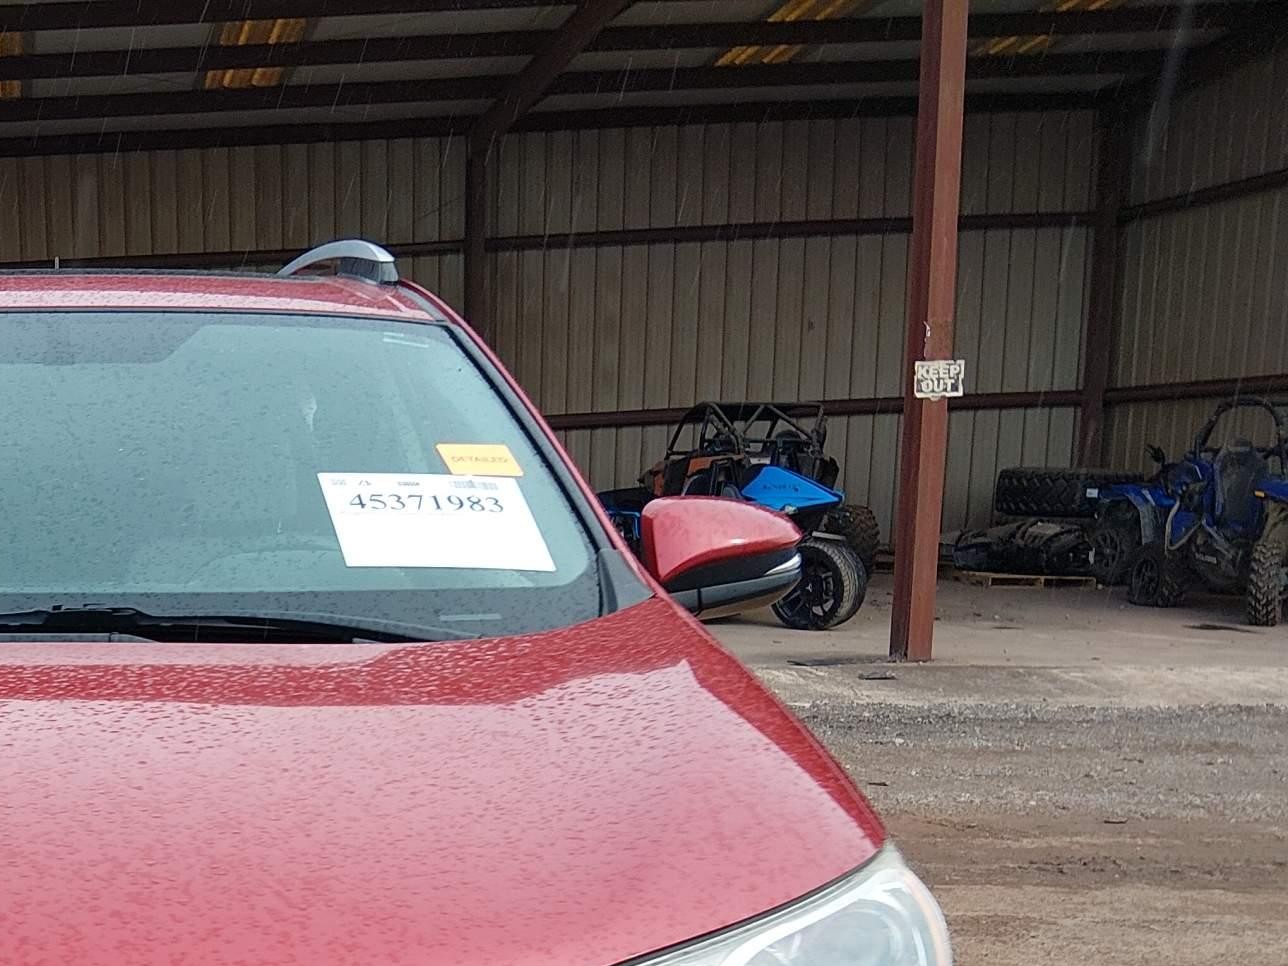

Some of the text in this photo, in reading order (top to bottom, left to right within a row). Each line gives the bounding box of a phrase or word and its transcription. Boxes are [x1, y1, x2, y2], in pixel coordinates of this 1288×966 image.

[917, 364, 960, 379] KEEP
[920, 379, 955, 392] OUT
[349, 493, 504, 513] 45371983
